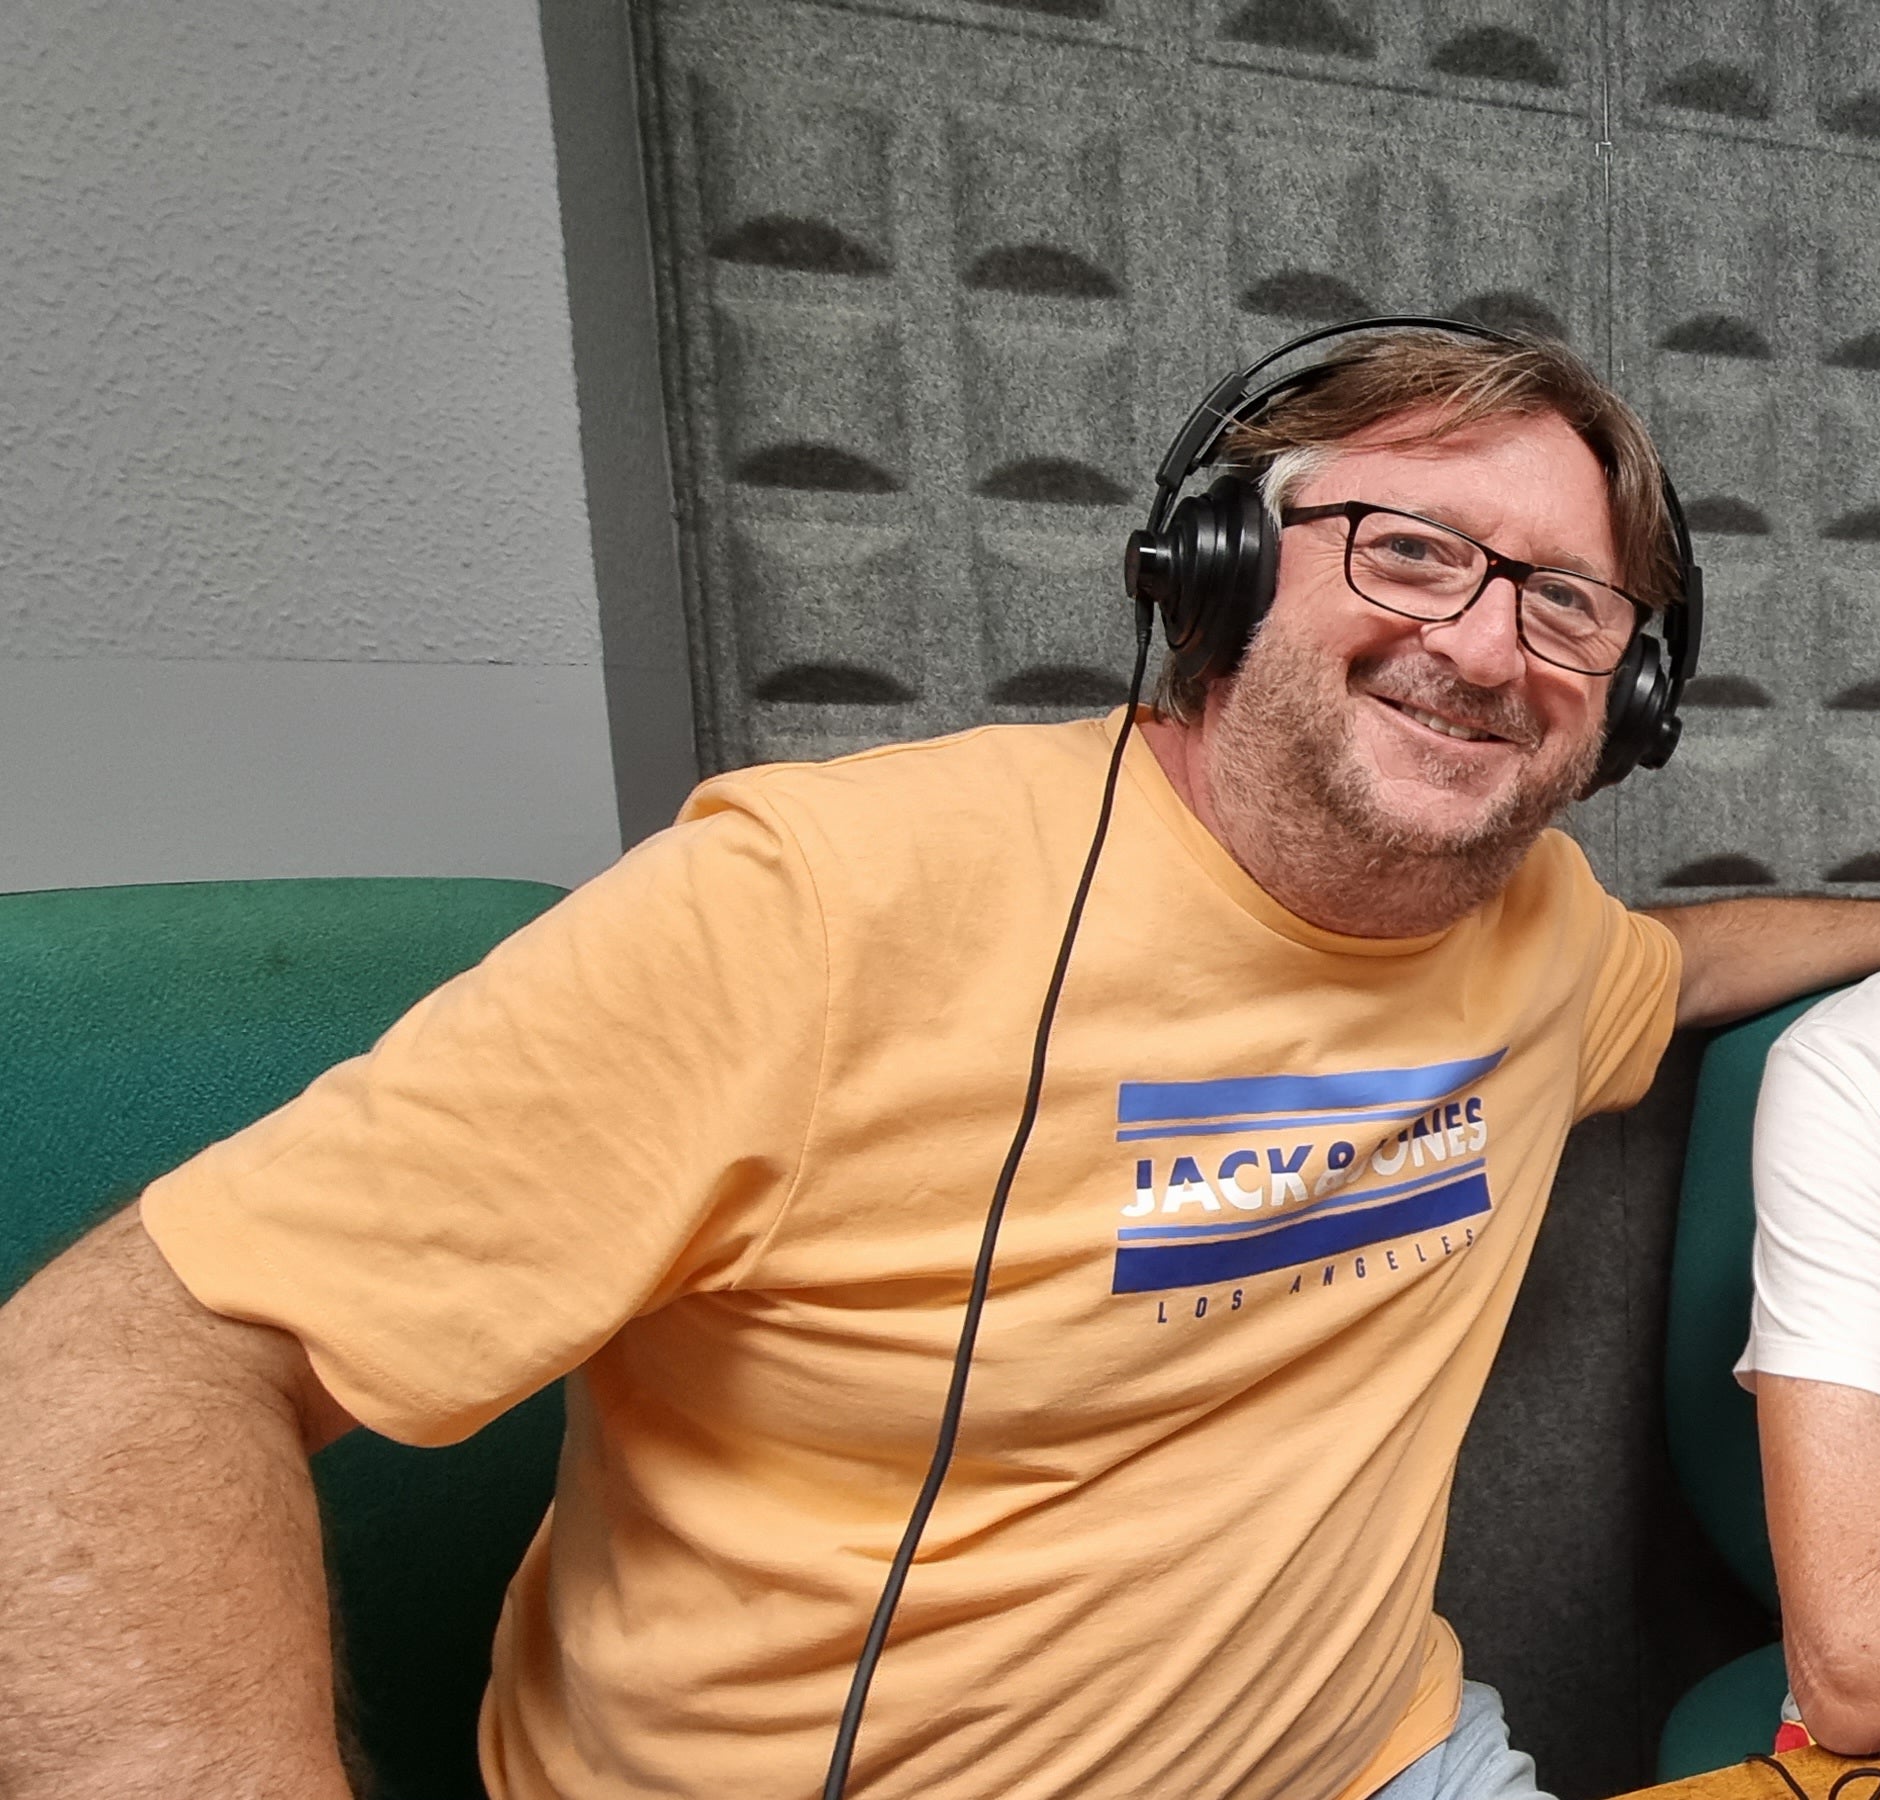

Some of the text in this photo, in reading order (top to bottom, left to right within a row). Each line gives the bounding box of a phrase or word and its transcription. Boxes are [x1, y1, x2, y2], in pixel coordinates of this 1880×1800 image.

[1120, 1144, 1314, 1218] JACK
[1157, 1227, 1475, 1324] LOS ANGELES
